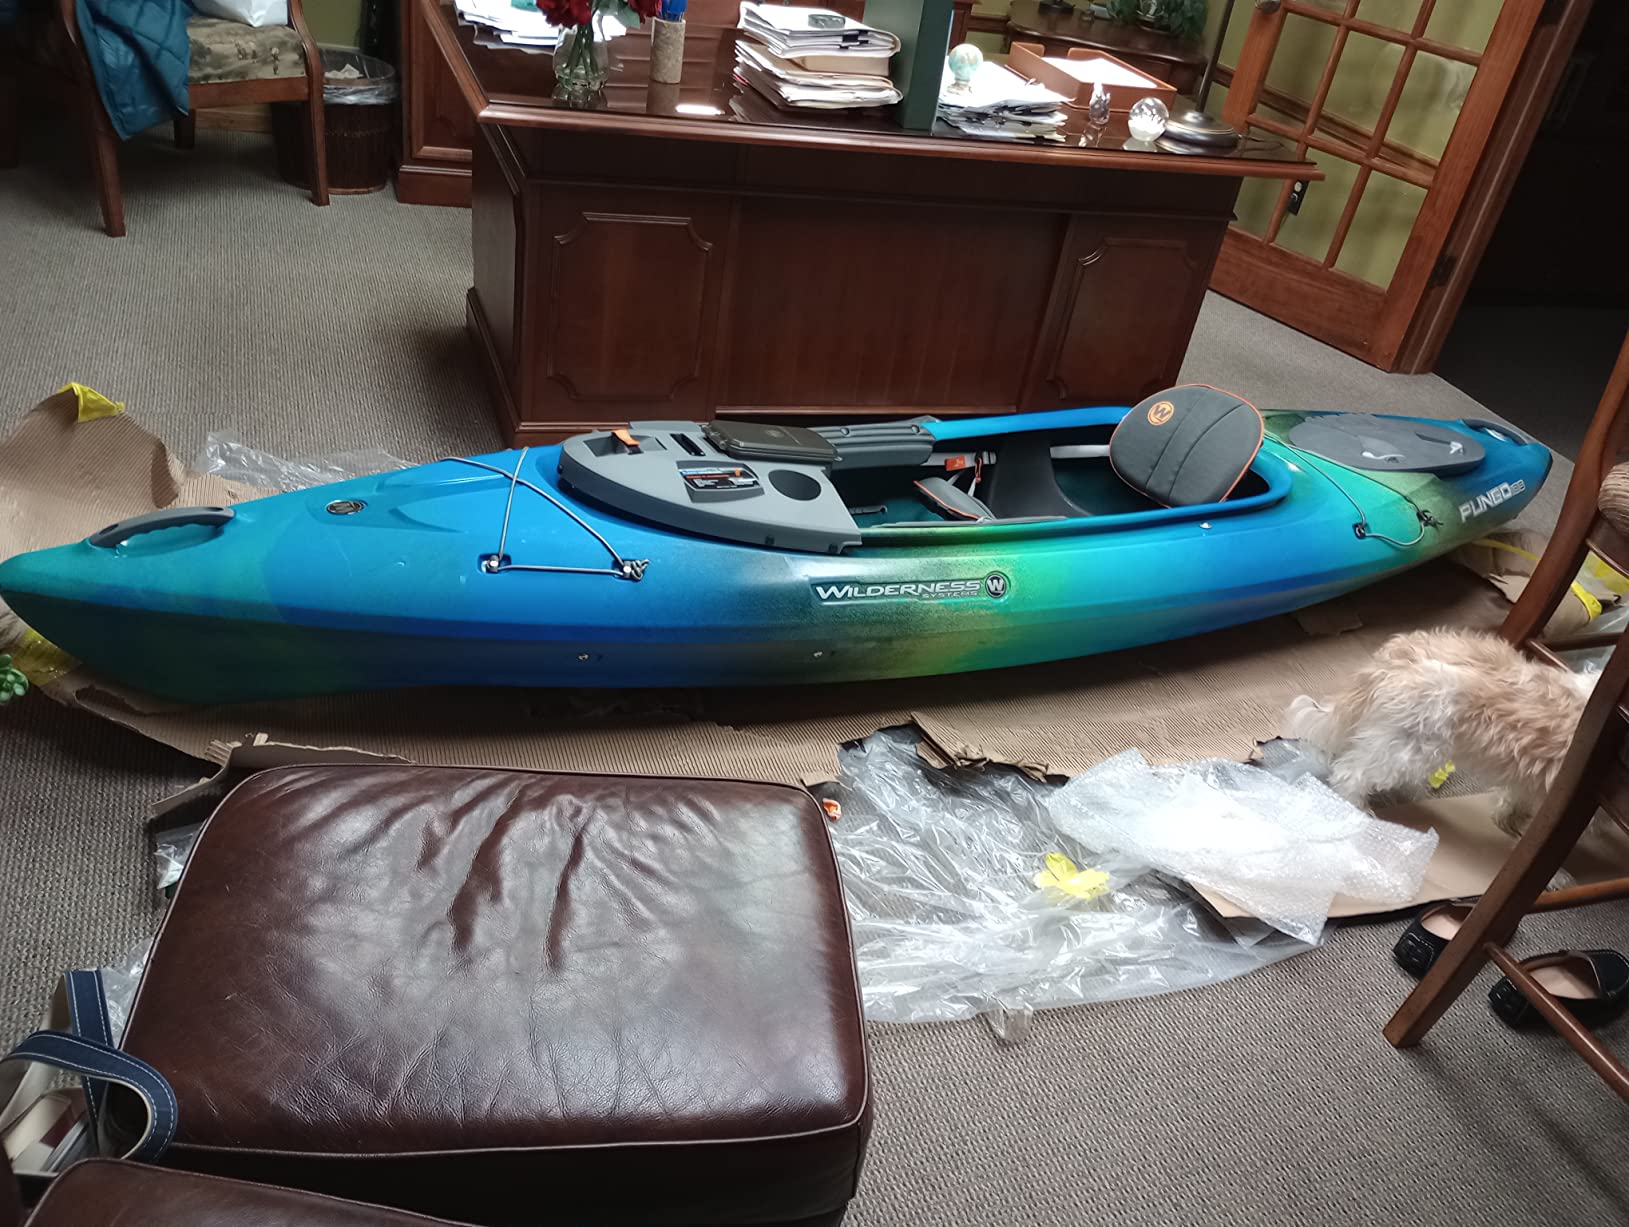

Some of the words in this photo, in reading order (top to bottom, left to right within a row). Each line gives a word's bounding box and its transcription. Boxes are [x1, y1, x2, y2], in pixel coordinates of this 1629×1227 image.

[1458, 481, 1512, 523] PUNGO
[815, 579, 981, 600] WILDERNESS
[922, 591, 978, 599] SYSTEMS
